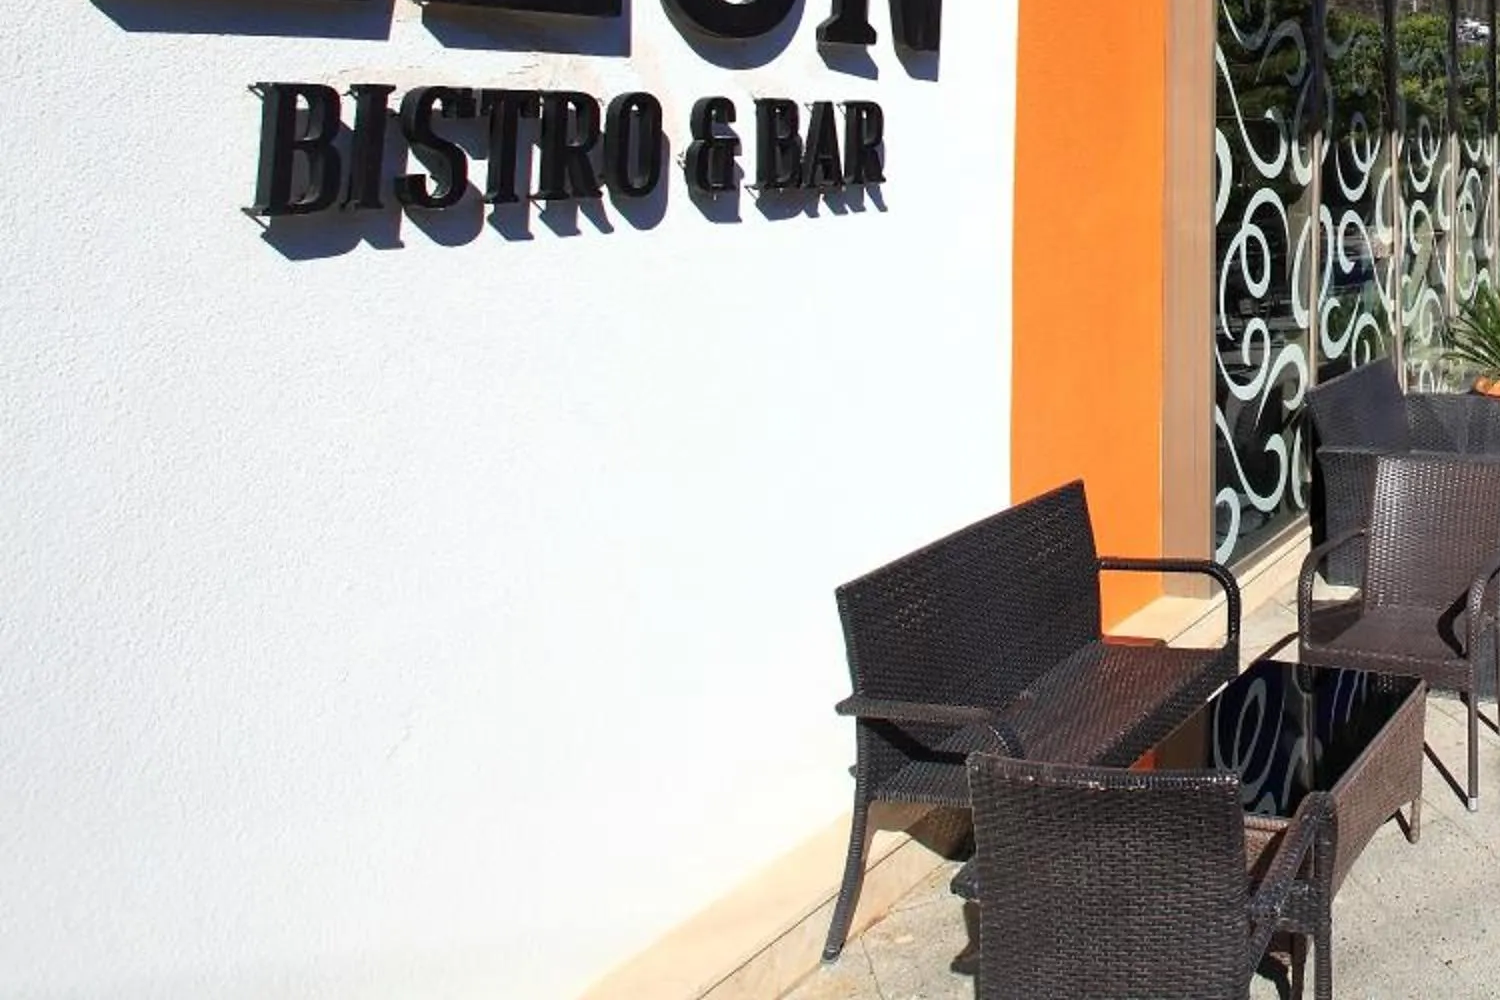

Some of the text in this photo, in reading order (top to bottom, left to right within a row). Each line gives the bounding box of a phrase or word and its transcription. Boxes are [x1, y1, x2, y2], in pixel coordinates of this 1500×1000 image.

[250, 82, 886, 216] BISTRO & BAR
